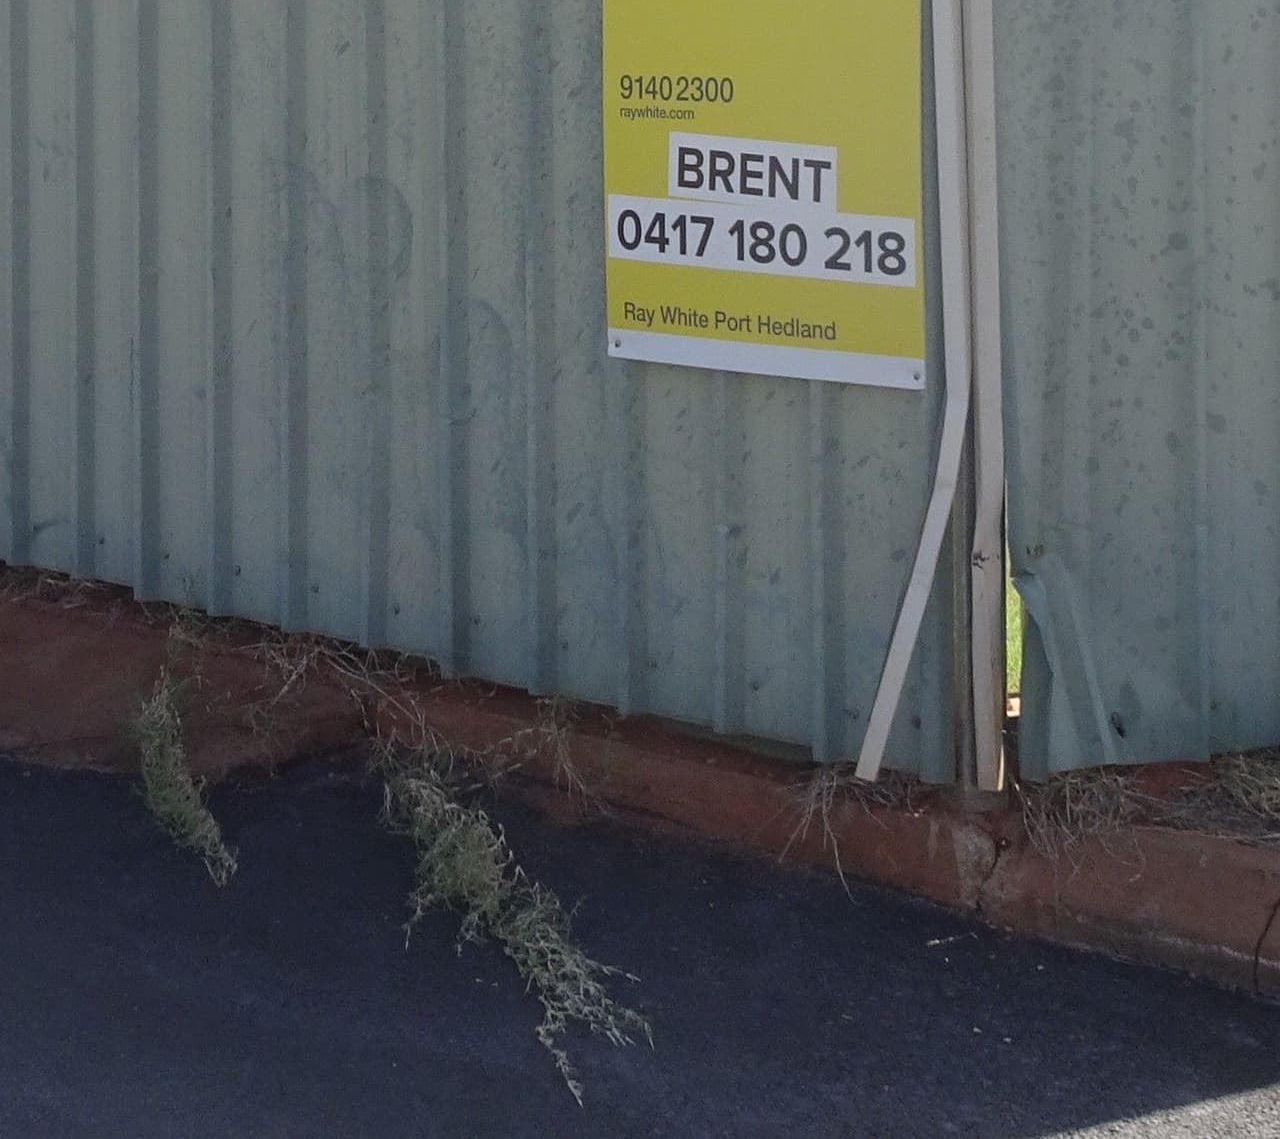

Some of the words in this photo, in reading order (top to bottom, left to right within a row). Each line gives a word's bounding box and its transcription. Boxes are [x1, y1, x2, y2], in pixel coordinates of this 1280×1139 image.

[620, 106, 695, 121] raywhite.com
[677, 146, 832, 203] BRENT
[617, 209, 715, 258] 0417
[727, 219, 808, 267] 180
[823, 226, 907, 276] 218
[623, 302, 655, 328] Ray
[660, 306, 709, 329] White
[715, 311, 752, 333] Port
[757, 316, 837, 341] Hedland
